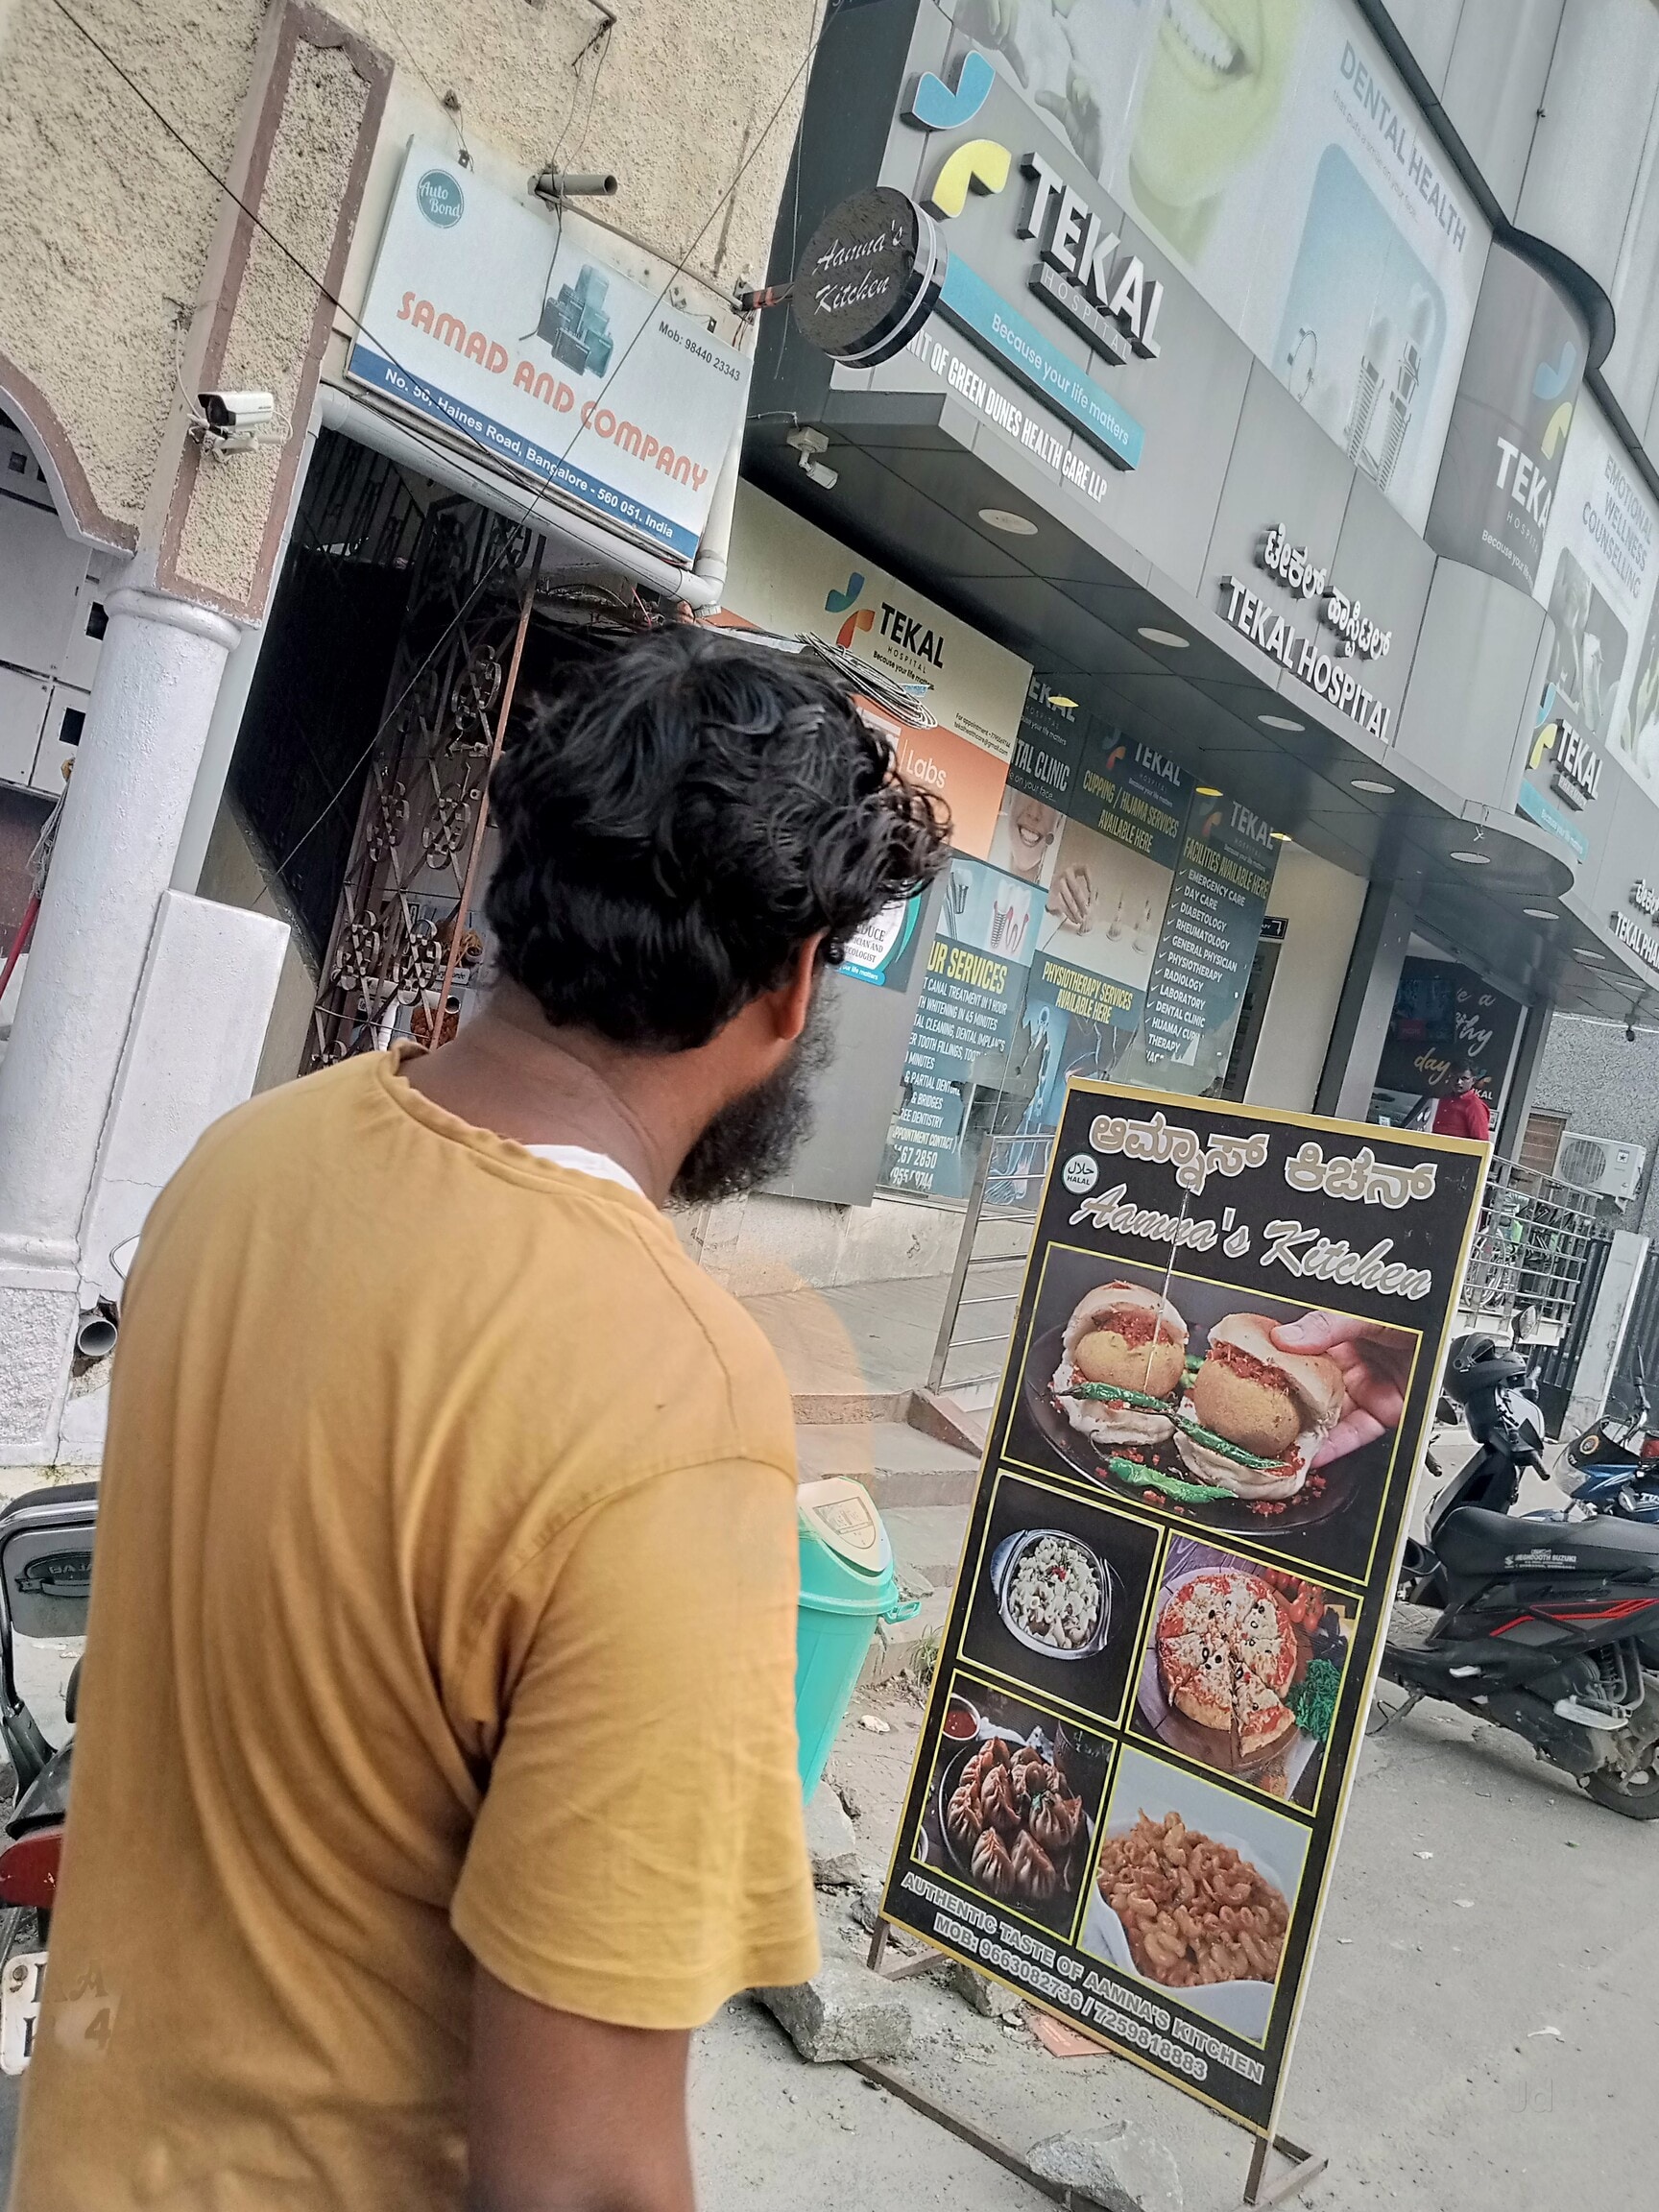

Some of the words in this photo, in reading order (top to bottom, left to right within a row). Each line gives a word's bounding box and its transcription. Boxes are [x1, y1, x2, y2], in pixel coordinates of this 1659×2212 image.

[1340, 39, 1405, 165] DENTAL
[1408, 148, 1467, 253] HEALTH
[420, 180, 448, 200] Auto
[429, 198, 461, 219] Bond
[1022, 152, 1164, 359] TEKAL
[814, 269, 890, 315] Kitchen
[1043, 267, 1128, 360] HOSPITAL
[659, 320, 684, 348] Mob:
[685, 340, 712, 366] 98440
[713, 355, 741, 382] 23343
[397, 291, 509, 374] SAMAD
[512, 360, 575, 414] AND
[580, 400, 709, 492] COMPANY
[992, 313, 1043, 372] Because
[1042, 362, 1070, 394] your
[1070, 382, 1089, 409] life
[1089, 401, 1130, 445] matters
[930, 343, 950, 375] OF
[948, 357, 987, 408] GREEN
[985, 387, 1022, 437] DUNES
[1021, 418, 1064, 469] HEALTH
[1062, 450, 1090, 492] CARE
[1088, 471, 1108, 502] LLP
[385, 369, 408, 391] No.
[438, 397, 483, 432] Haines
[486, 424, 522, 456] Road,
[526, 447, 588, 492] Bangalore
[597, 488, 618, 508] 560
[645, 515, 674, 539] India
[1605, 452, 1653, 545] EMOTIONAL
[1482, 529, 1512, 559] Because
[1582, 501, 1641, 599] COUNSELLING
[1605, 492, 1647, 572] WELLNESS
[881, 602, 945, 669] TEKAL
[874, 650, 896, 668] Because
[895, 663, 907, 677] your
[888, 645, 926, 674] HOSPITAL
[1226, 576, 1295, 669] TEKAL
[1297, 637, 1391, 744] HOSPITAL
[905, 749, 947, 789] Labs
[1034, 751, 1070, 792] CLINIC
[1556, 719, 1603, 801] TEKAL
[1083, 770, 1116, 804] CUPPING
[1120, 791, 1149, 822] HIJAMA
[1147, 805, 1179, 838] SERVICES
[1098, 809, 1135, 844] AVAILABLE
[1133, 828, 1153, 854] HERE
[1231, 800, 1274, 851] TEKAL
[1184, 836, 1221, 874] FACILITIES
[1218, 855, 1253, 891] AVAILABLE
[1251, 875, 1269, 899] HERE
[1184, 885, 1199, 902] DAY
[1199, 894, 1218, 910] CARE
[1189, 869, 1229, 897] EMERGENCY
[1229, 890, 1246, 907] CARE
[1176, 919, 1230, 951] RHEUMATOLOGY
[1180, 902, 1227, 932] DIABETOLOGY
[1615, 911, 1642, 953] TEKAL
[871, 943, 883, 952] AND
[1172, 935, 1202, 958] GENERAL
[1203, 949, 1238, 973] PHYSICIAN
[947, 947, 1008, 995] SERVICES
[1042, 961, 1101, 999] PHYSIOTHERAPY
[1099, 982, 1134, 1011] SERVICES
[1164, 968, 1204, 993] RADIOLOGY
[1167, 951, 1223, 983] PHYSIOTHERAPY
[926, 998, 959, 1019] WHITENING
[957, 1006, 965, 1020] IN
[965, 1008, 974, 1023] 45
[973, 1012, 998, 1031] MINUTES
[927, 978, 947, 997] CANAL
[948, 985, 982, 1006] TREATMENT
[980, 995, 988, 1008] IN
[991, 998, 1008, 1016] HOUR
[1055, 988, 1094, 1018] AVAILABLE
[1092, 1001, 1113, 1024] HERE
[1156, 1000, 1183, 1020] DENTAL
[1184, 1011, 1206, 1028] CLINIC
[1160, 984, 1206, 1011] LABORATORY
[1479, 994, 1496, 1006] a
[917, 1034, 937, 1052] TOOTH
[936, 1040, 963, 1061] FILLINGS,
[926, 1017, 955, 1039] CLEANING,
[955, 1026, 977, 1044] DENTAL
[1148, 1033, 1181, 1053] THERAPY
[903, 1070, 910, 1083] &
[910, 1071, 935, 1089] PARTIAL
[908, 1052, 936, 1070] MINUTES
[911, 1092, 917, 1104] &
[917, 1093, 944, 1110] BRIDGES
[911, 1109, 944, 1128] DENTISTRY
[913, 1148, 938, 1169] 2850
[928, 1134, 953, 1150] CONTACT
[1067, 1161, 1094, 1174] حلال
[1067, 1174, 1091, 1186] HALAL
[1285, 1142, 1437, 1210] ಕಿಚನ್
[1069, 1183, 1250, 1259] Aamna's
[1260, 1218, 1432, 1301] Kitchen
[901, 1871, 998, 1935] AUTHENTIC
[999, 1921, 1056, 1968] TASTE
[1056, 1955, 1085, 1982] OF
[1083, 1963, 1171, 2032] AAMNA'S
[1171, 2016, 1265, 2085] KITCHEN
[933, 1911, 979, 1953] MOB:
[978, 1937, 1085, 2010] 9663082736
[1093, 2001, 1208, 2081] 7259818883
